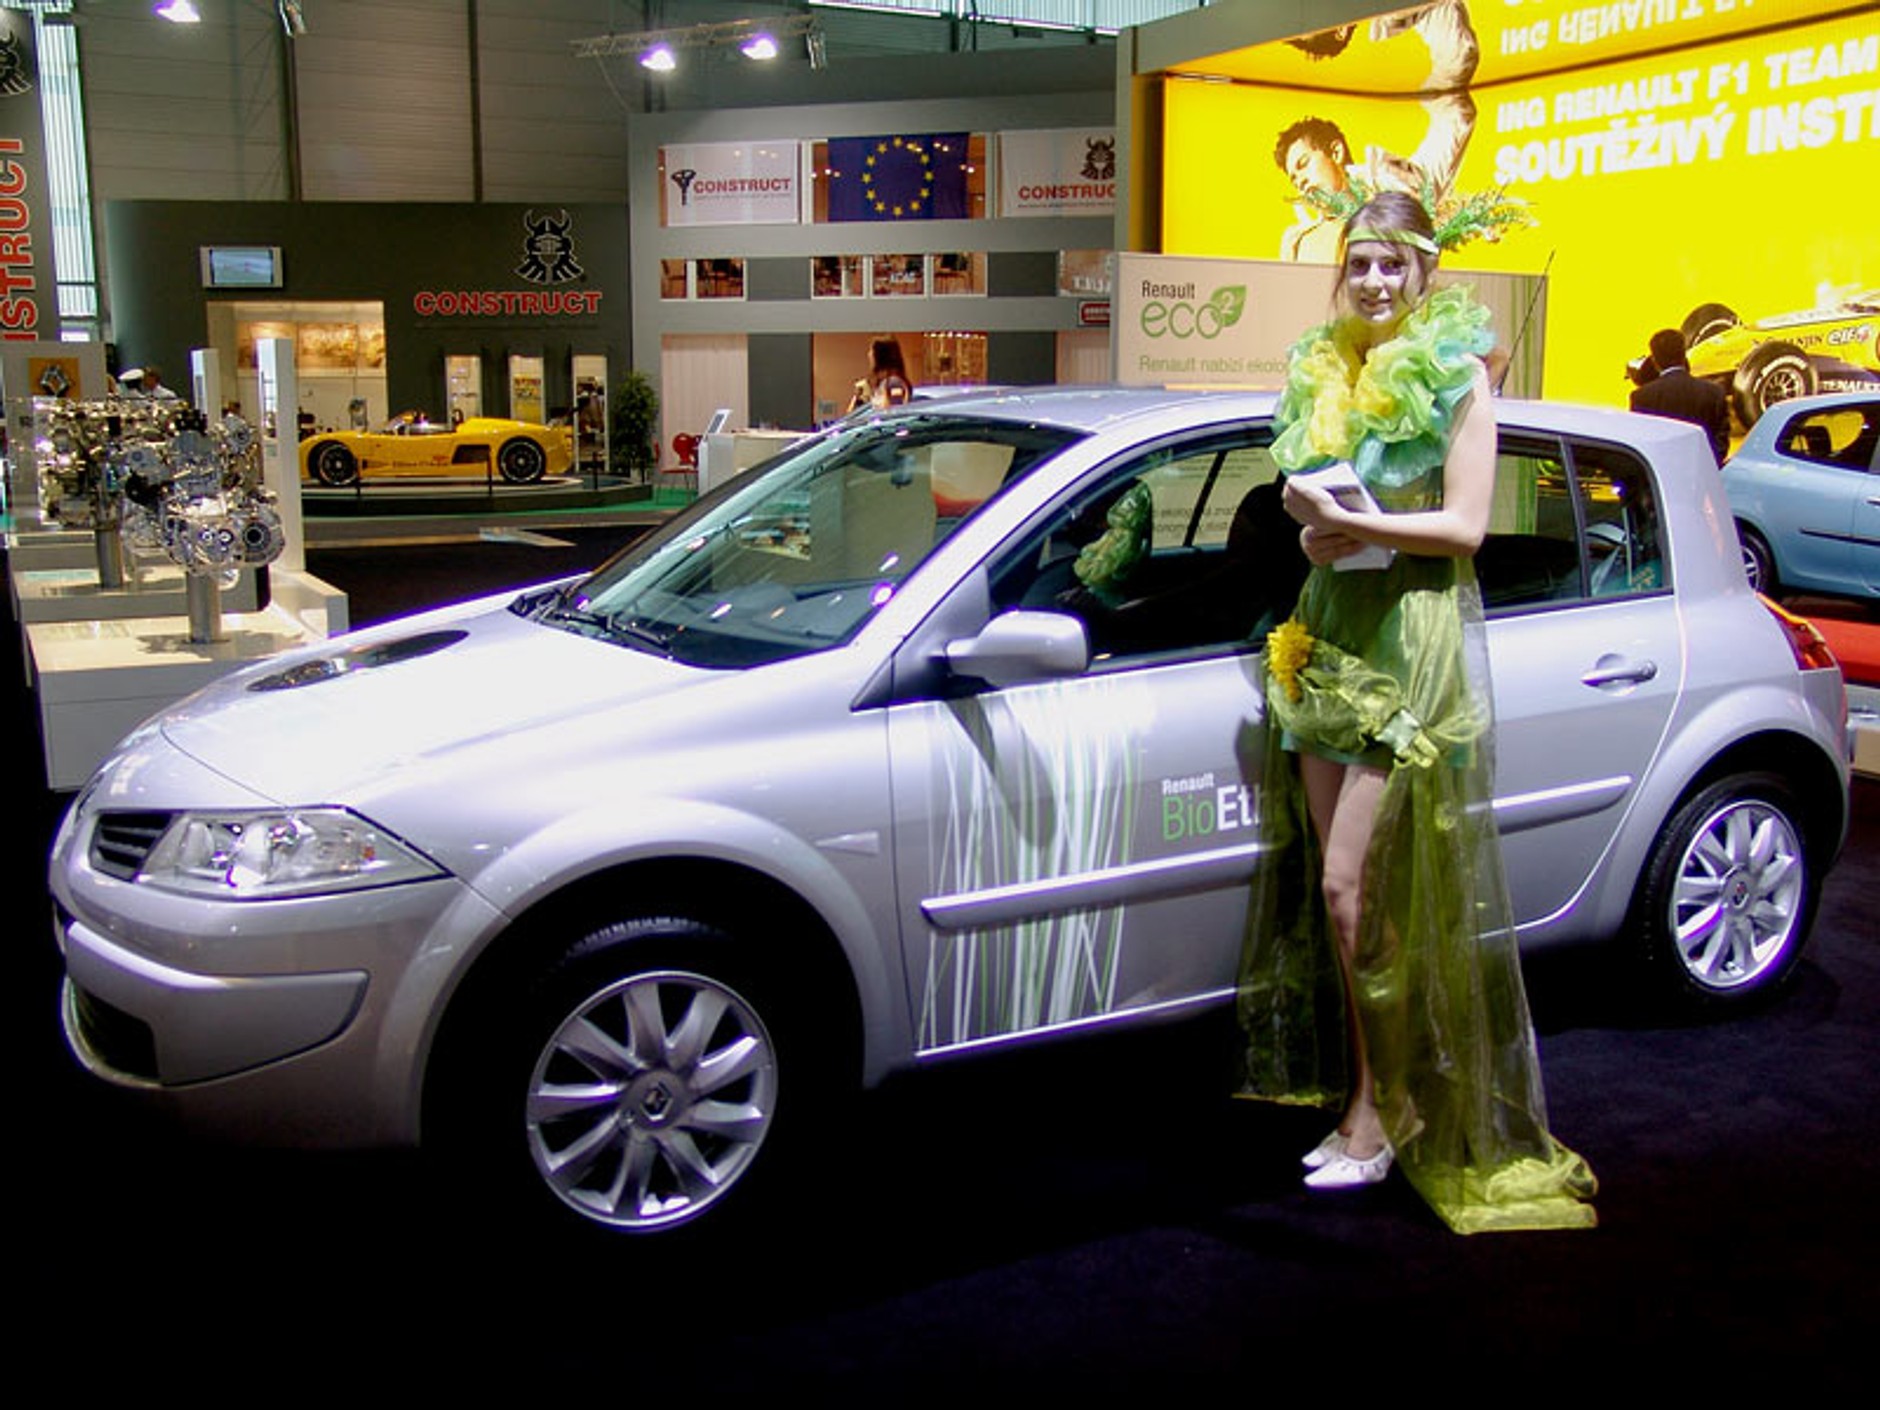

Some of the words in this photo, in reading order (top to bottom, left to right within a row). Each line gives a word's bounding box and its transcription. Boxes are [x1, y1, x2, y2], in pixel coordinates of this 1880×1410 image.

[1496, 96, 1546, 133] ING
[1554, 69, 1700, 124] RENAULT
[1708, 59, 1749, 100] F1
[1764, 34, 1880, 90] TEAM
[1493, 101, 1737, 186] SOUTĚŽIVÝ
[693, 177, 791, 194] CONSTRUCT
[1141, 279, 1195, 299] Renault
[413, 290, 602, 316] CONSTRUCT
[1139, 354, 1196, 373] Renault
[1162, 772, 1215, 796] Renault
